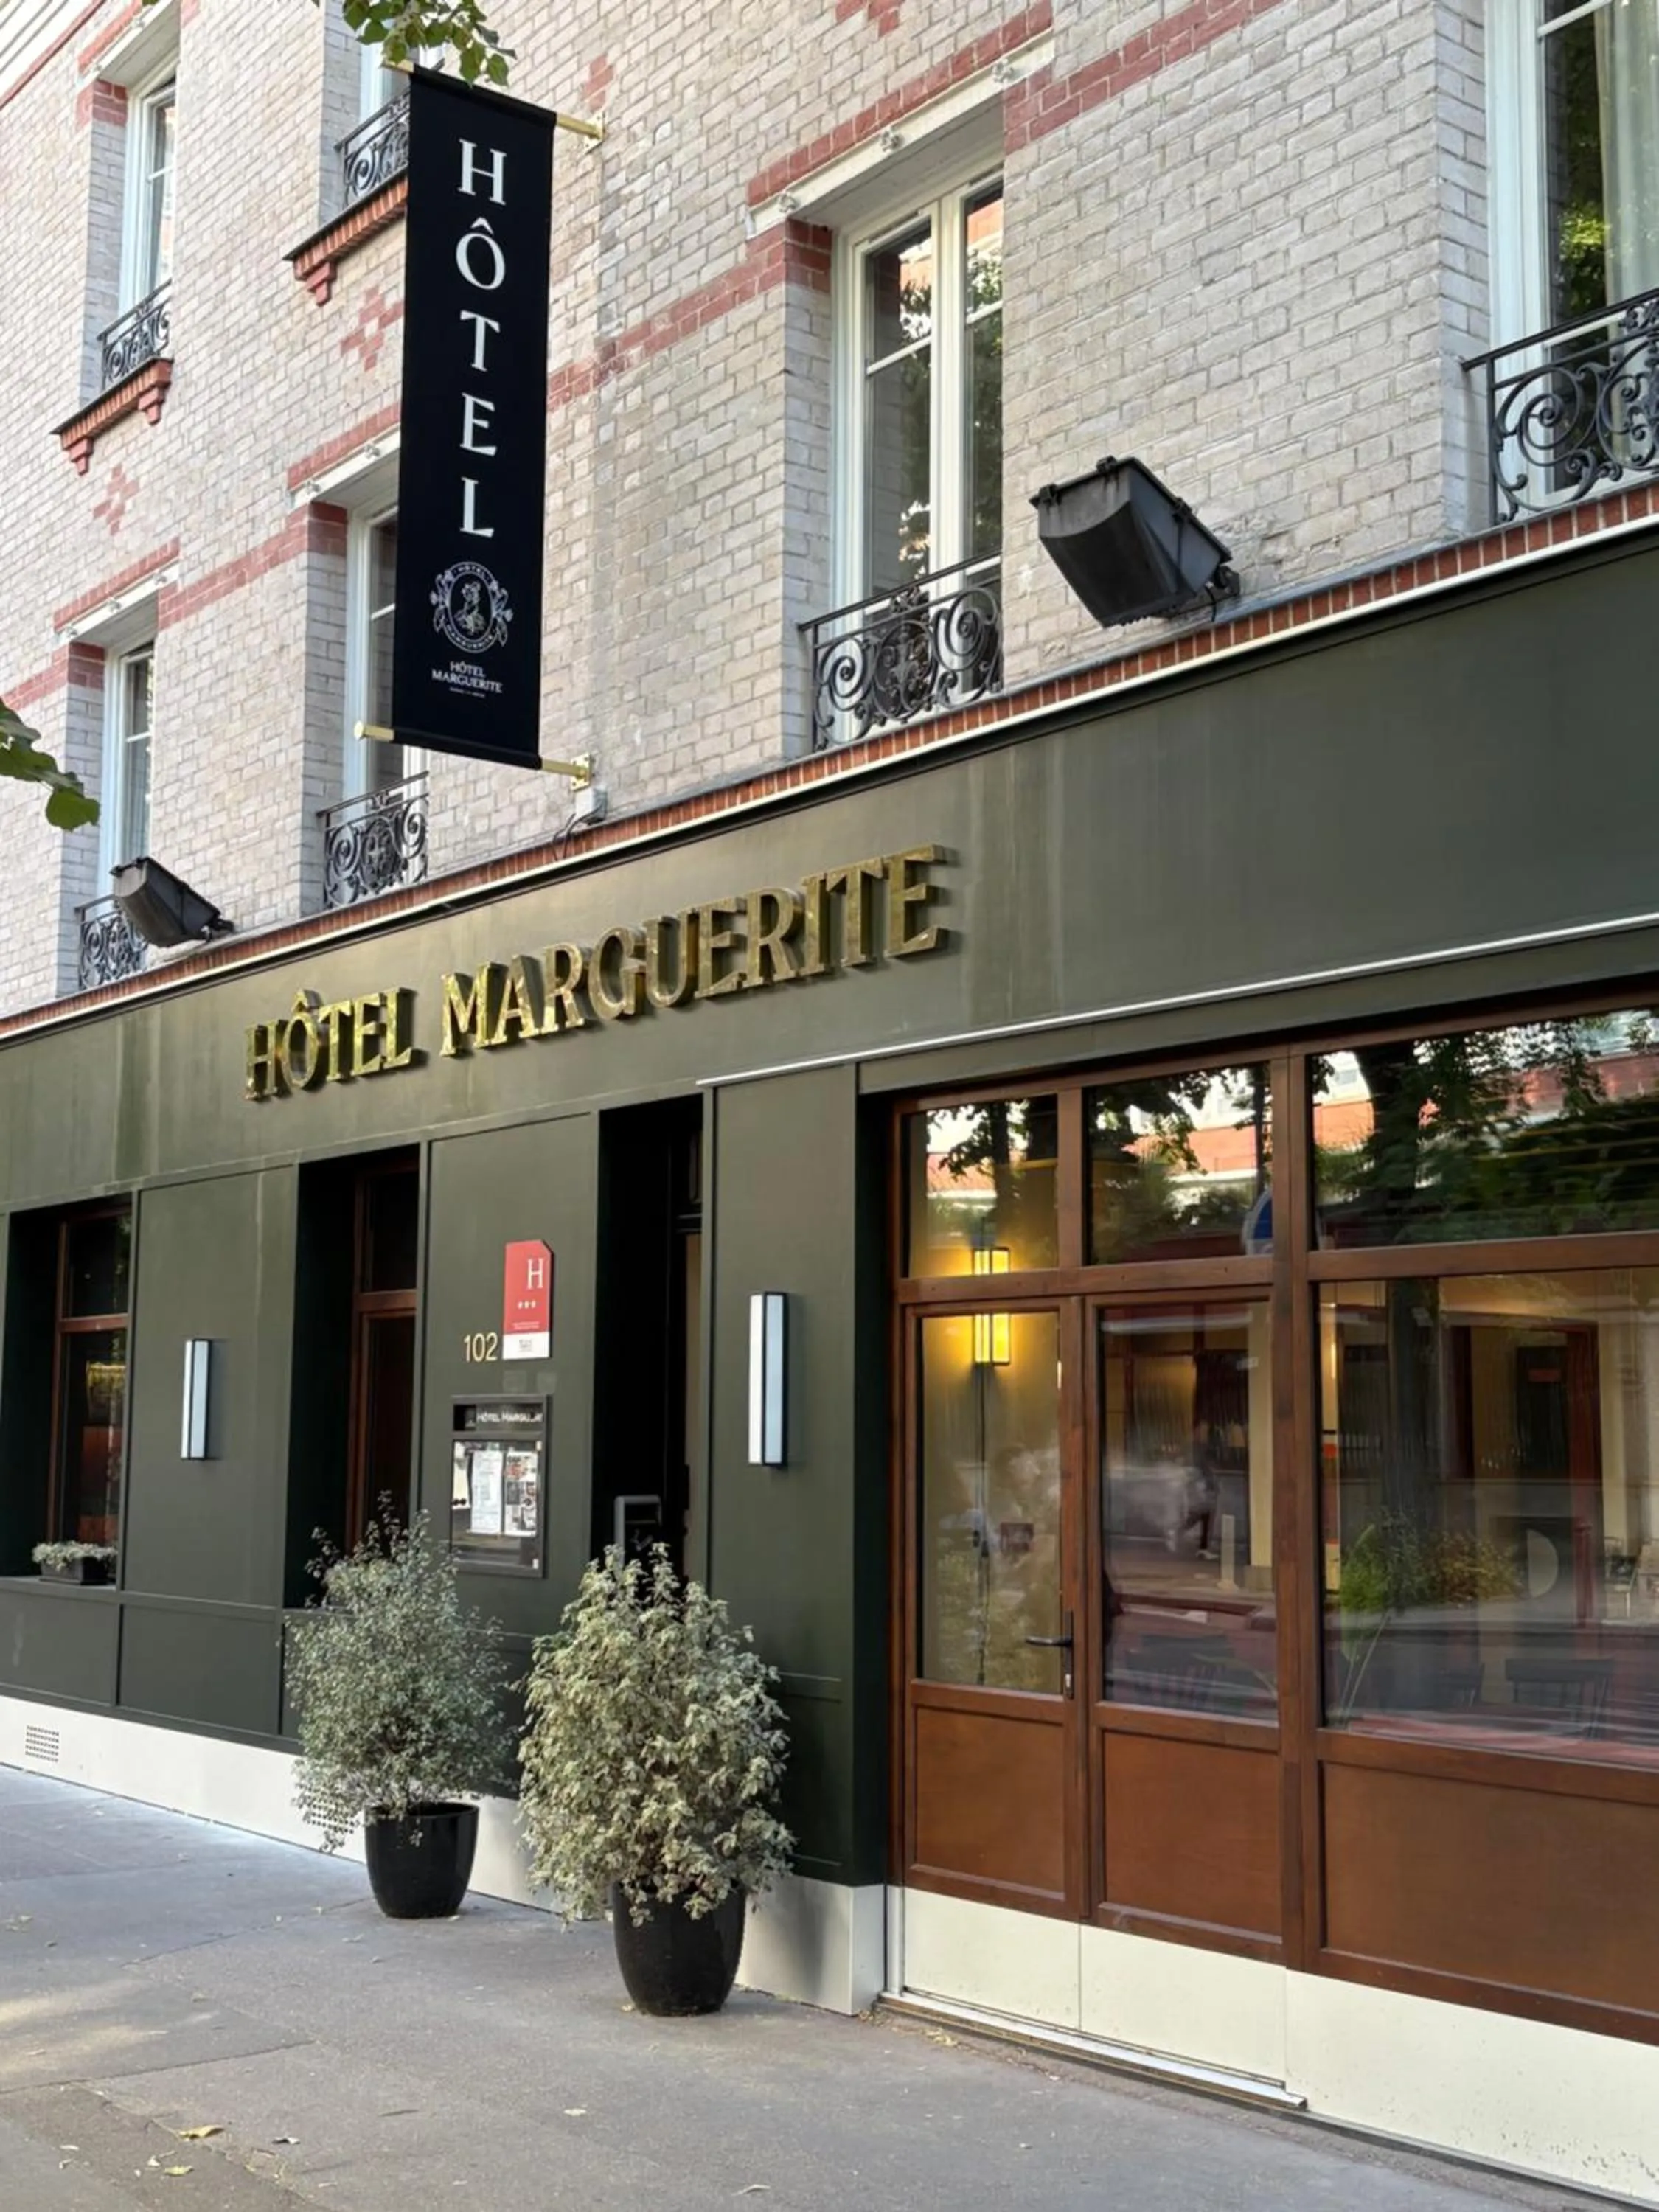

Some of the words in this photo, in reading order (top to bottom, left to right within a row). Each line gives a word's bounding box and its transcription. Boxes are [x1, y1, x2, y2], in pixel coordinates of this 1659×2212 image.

[456, 139, 507, 538] HÔTEL
[431, 669, 504, 693] MARGUERITE
[450, 661, 486, 677] HÔTEL
[245, 988, 414, 1101] HÔTEL
[439, 844, 944, 1058] MARGUERITE
[527, 1257, 544, 1290] H
[464, 1332, 498, 1363] 102
